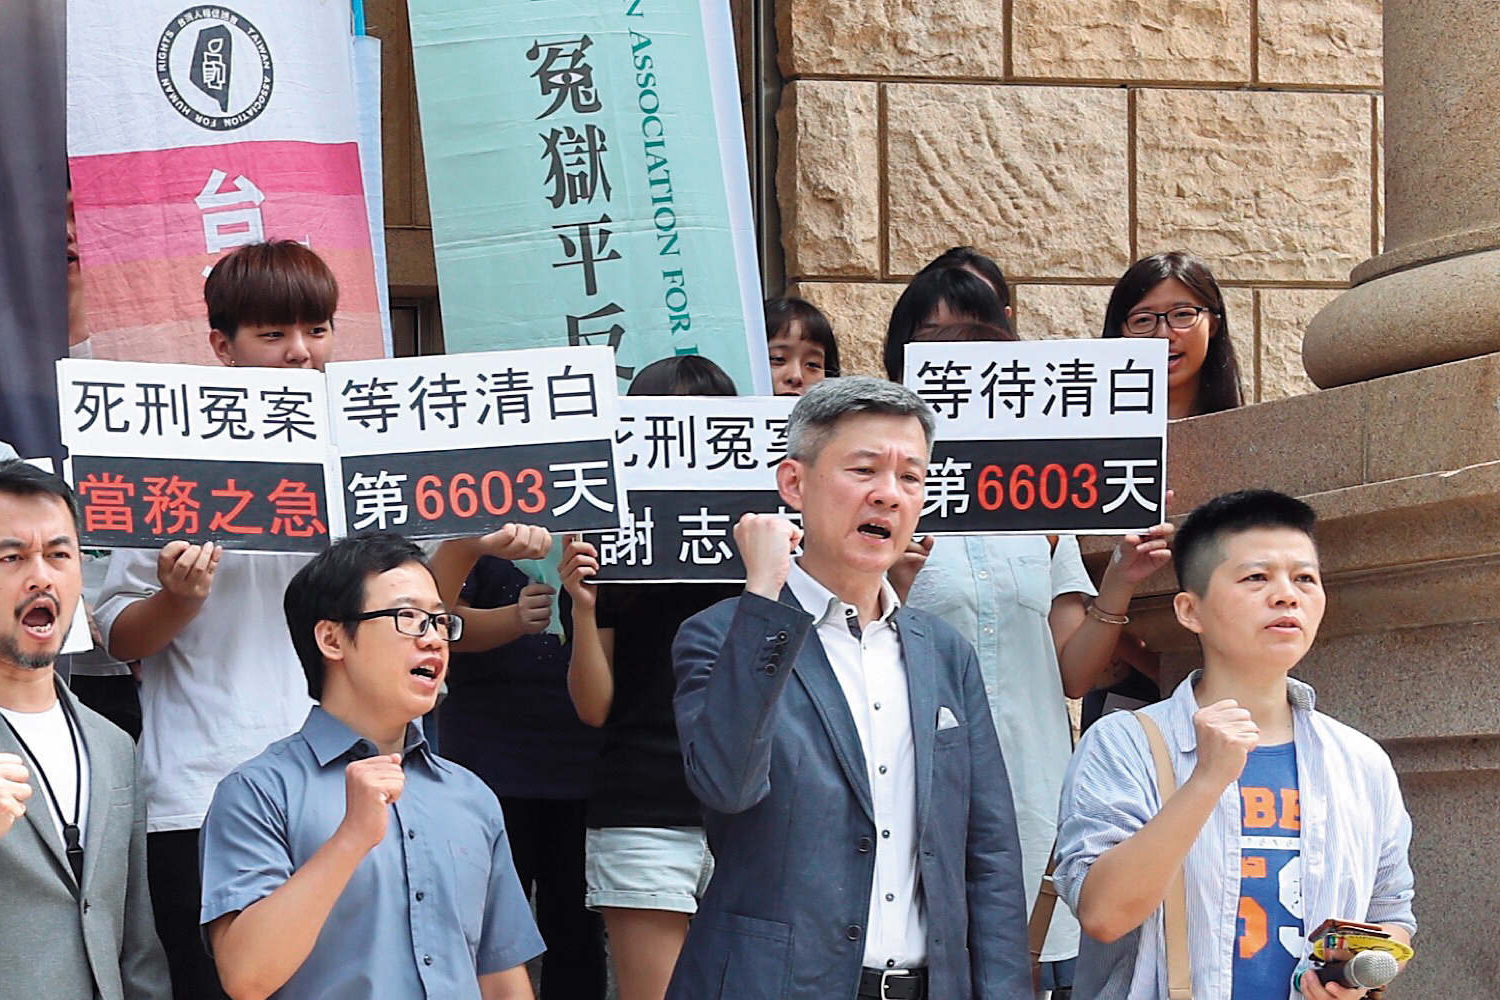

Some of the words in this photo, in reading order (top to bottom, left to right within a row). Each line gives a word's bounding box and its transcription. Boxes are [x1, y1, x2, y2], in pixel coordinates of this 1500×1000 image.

[157, 29, 175, 72] RIGHTS
[247, 27, 271, 69] TAIWAN
[160, 78, 191, 115] HUMAN
[194, 113, 217, 127] FOR
[223, 75, 272, 127] ASSOCIATION
[628, 28, 681, 256] ASSOCIATION
[662, 268, 693, 336] FOR
[194, 168, 266, 278] 台
[72, 380, 317, 442] 死刑冤案
[341, 365, 598, 433] 等待清白
[917, 358, 1155, 419] 等待清白
[79, 472, 327, 537] 當務之急
[347, 460, 615, 530] 第6603天
[919, 457, 1159, 518] 第6603天
[600, 506, 805, 566] 謝志
